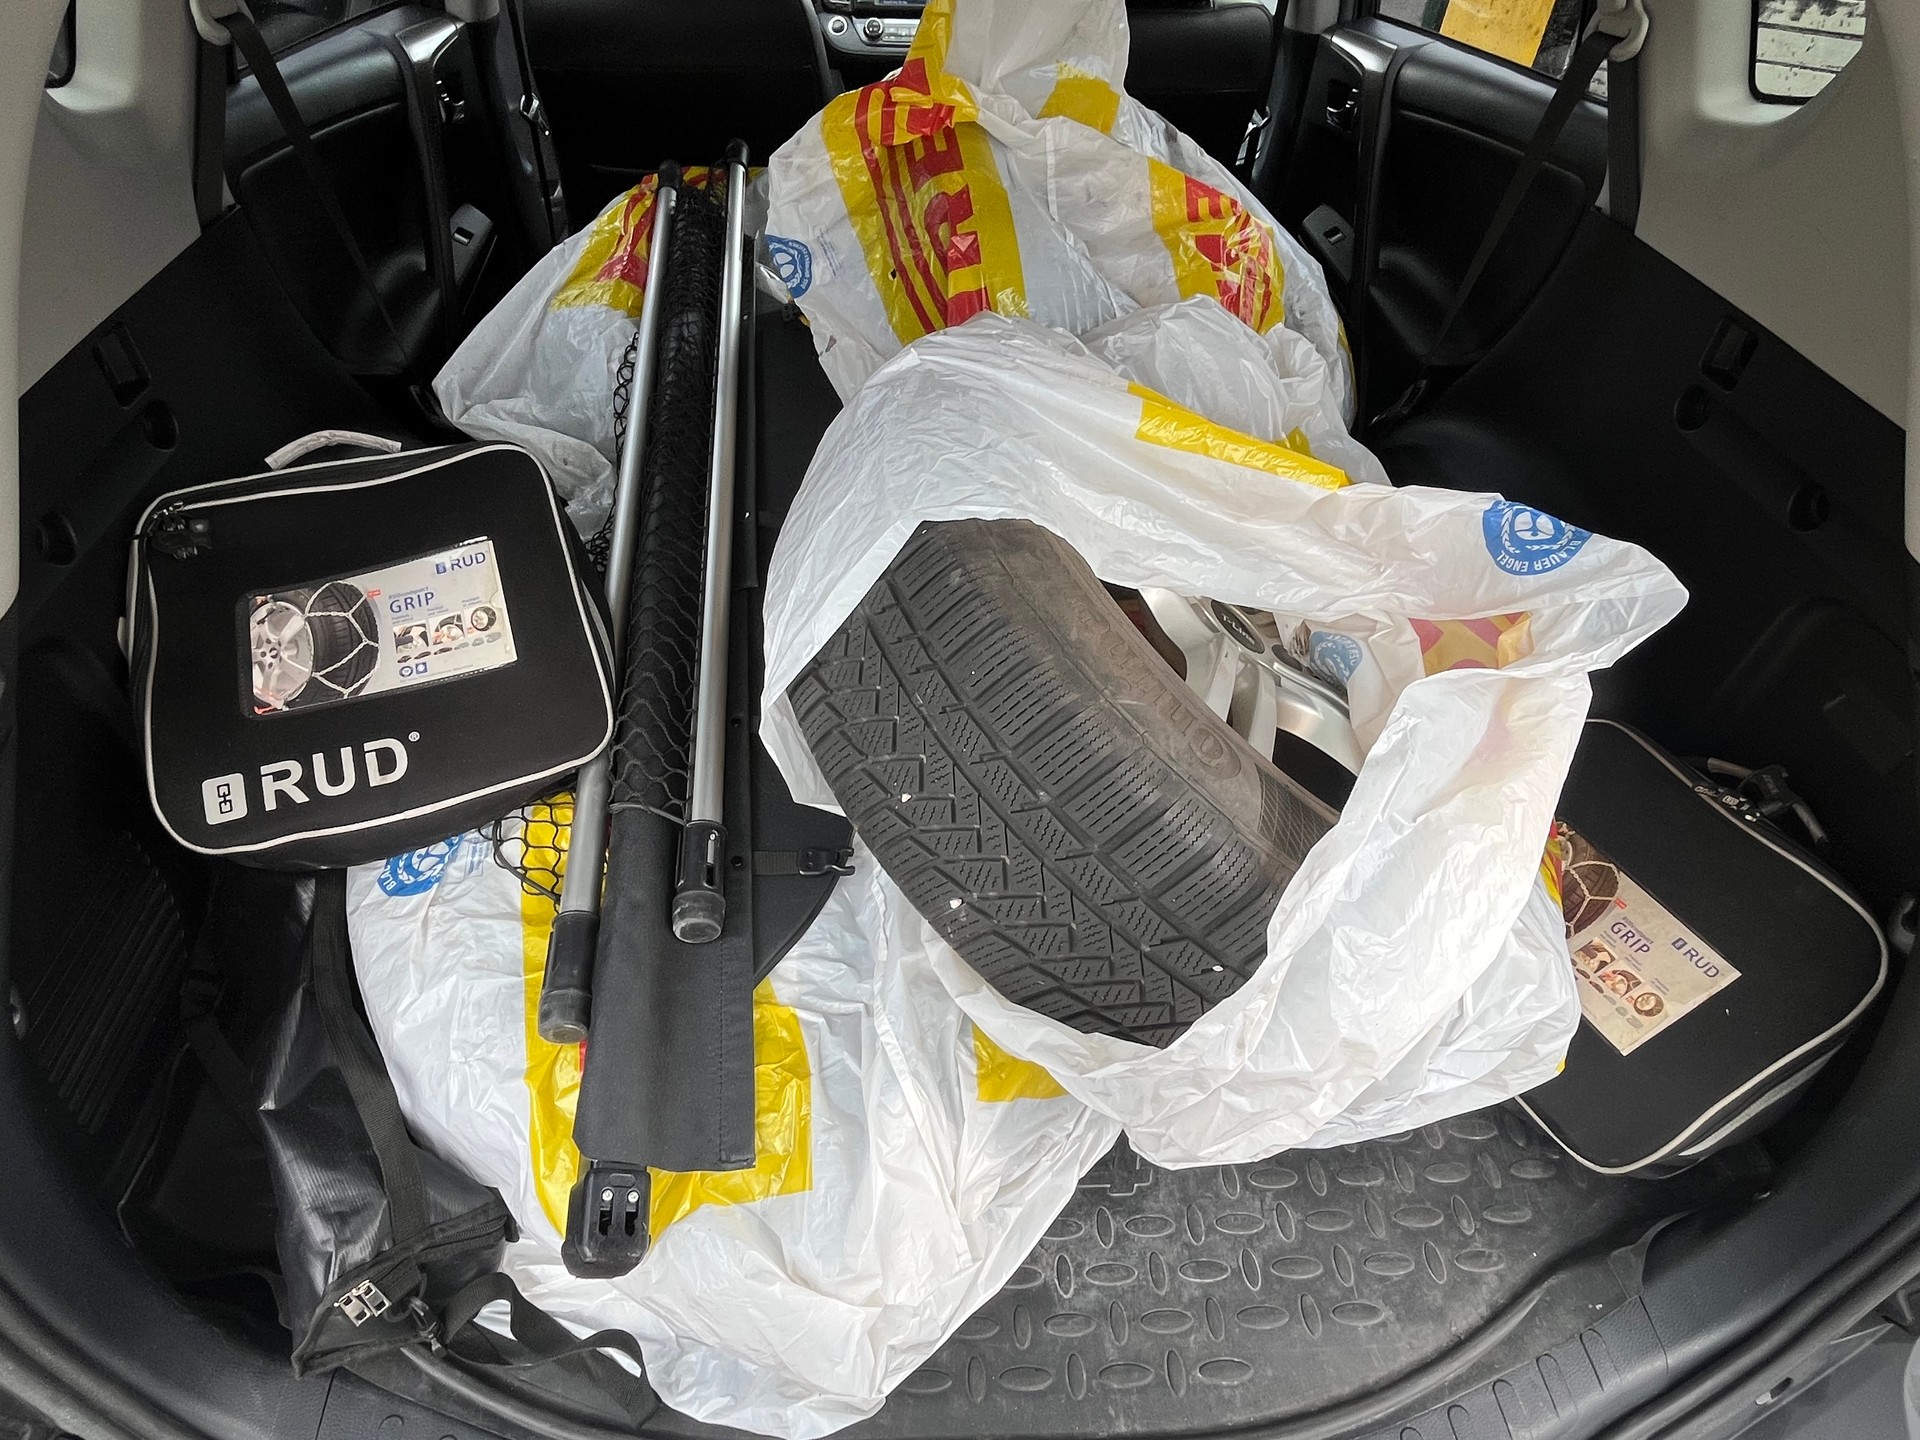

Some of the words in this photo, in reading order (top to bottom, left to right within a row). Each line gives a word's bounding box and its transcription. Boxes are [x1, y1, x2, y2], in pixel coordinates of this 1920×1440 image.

[450, 552, 486, 571] RUD
[1496, 550, 1529, 572] ENGEL
[1533, 540, 1582, 571] BLAUER
[389, 591, 434, 613] GRIP
[1221, 613, 1255, 645] T-Line
[259, 737, 409, 812] RUD
[1610, 921, 1651, 953] GRIP
[1683, 947, 1720, 978] RUD
